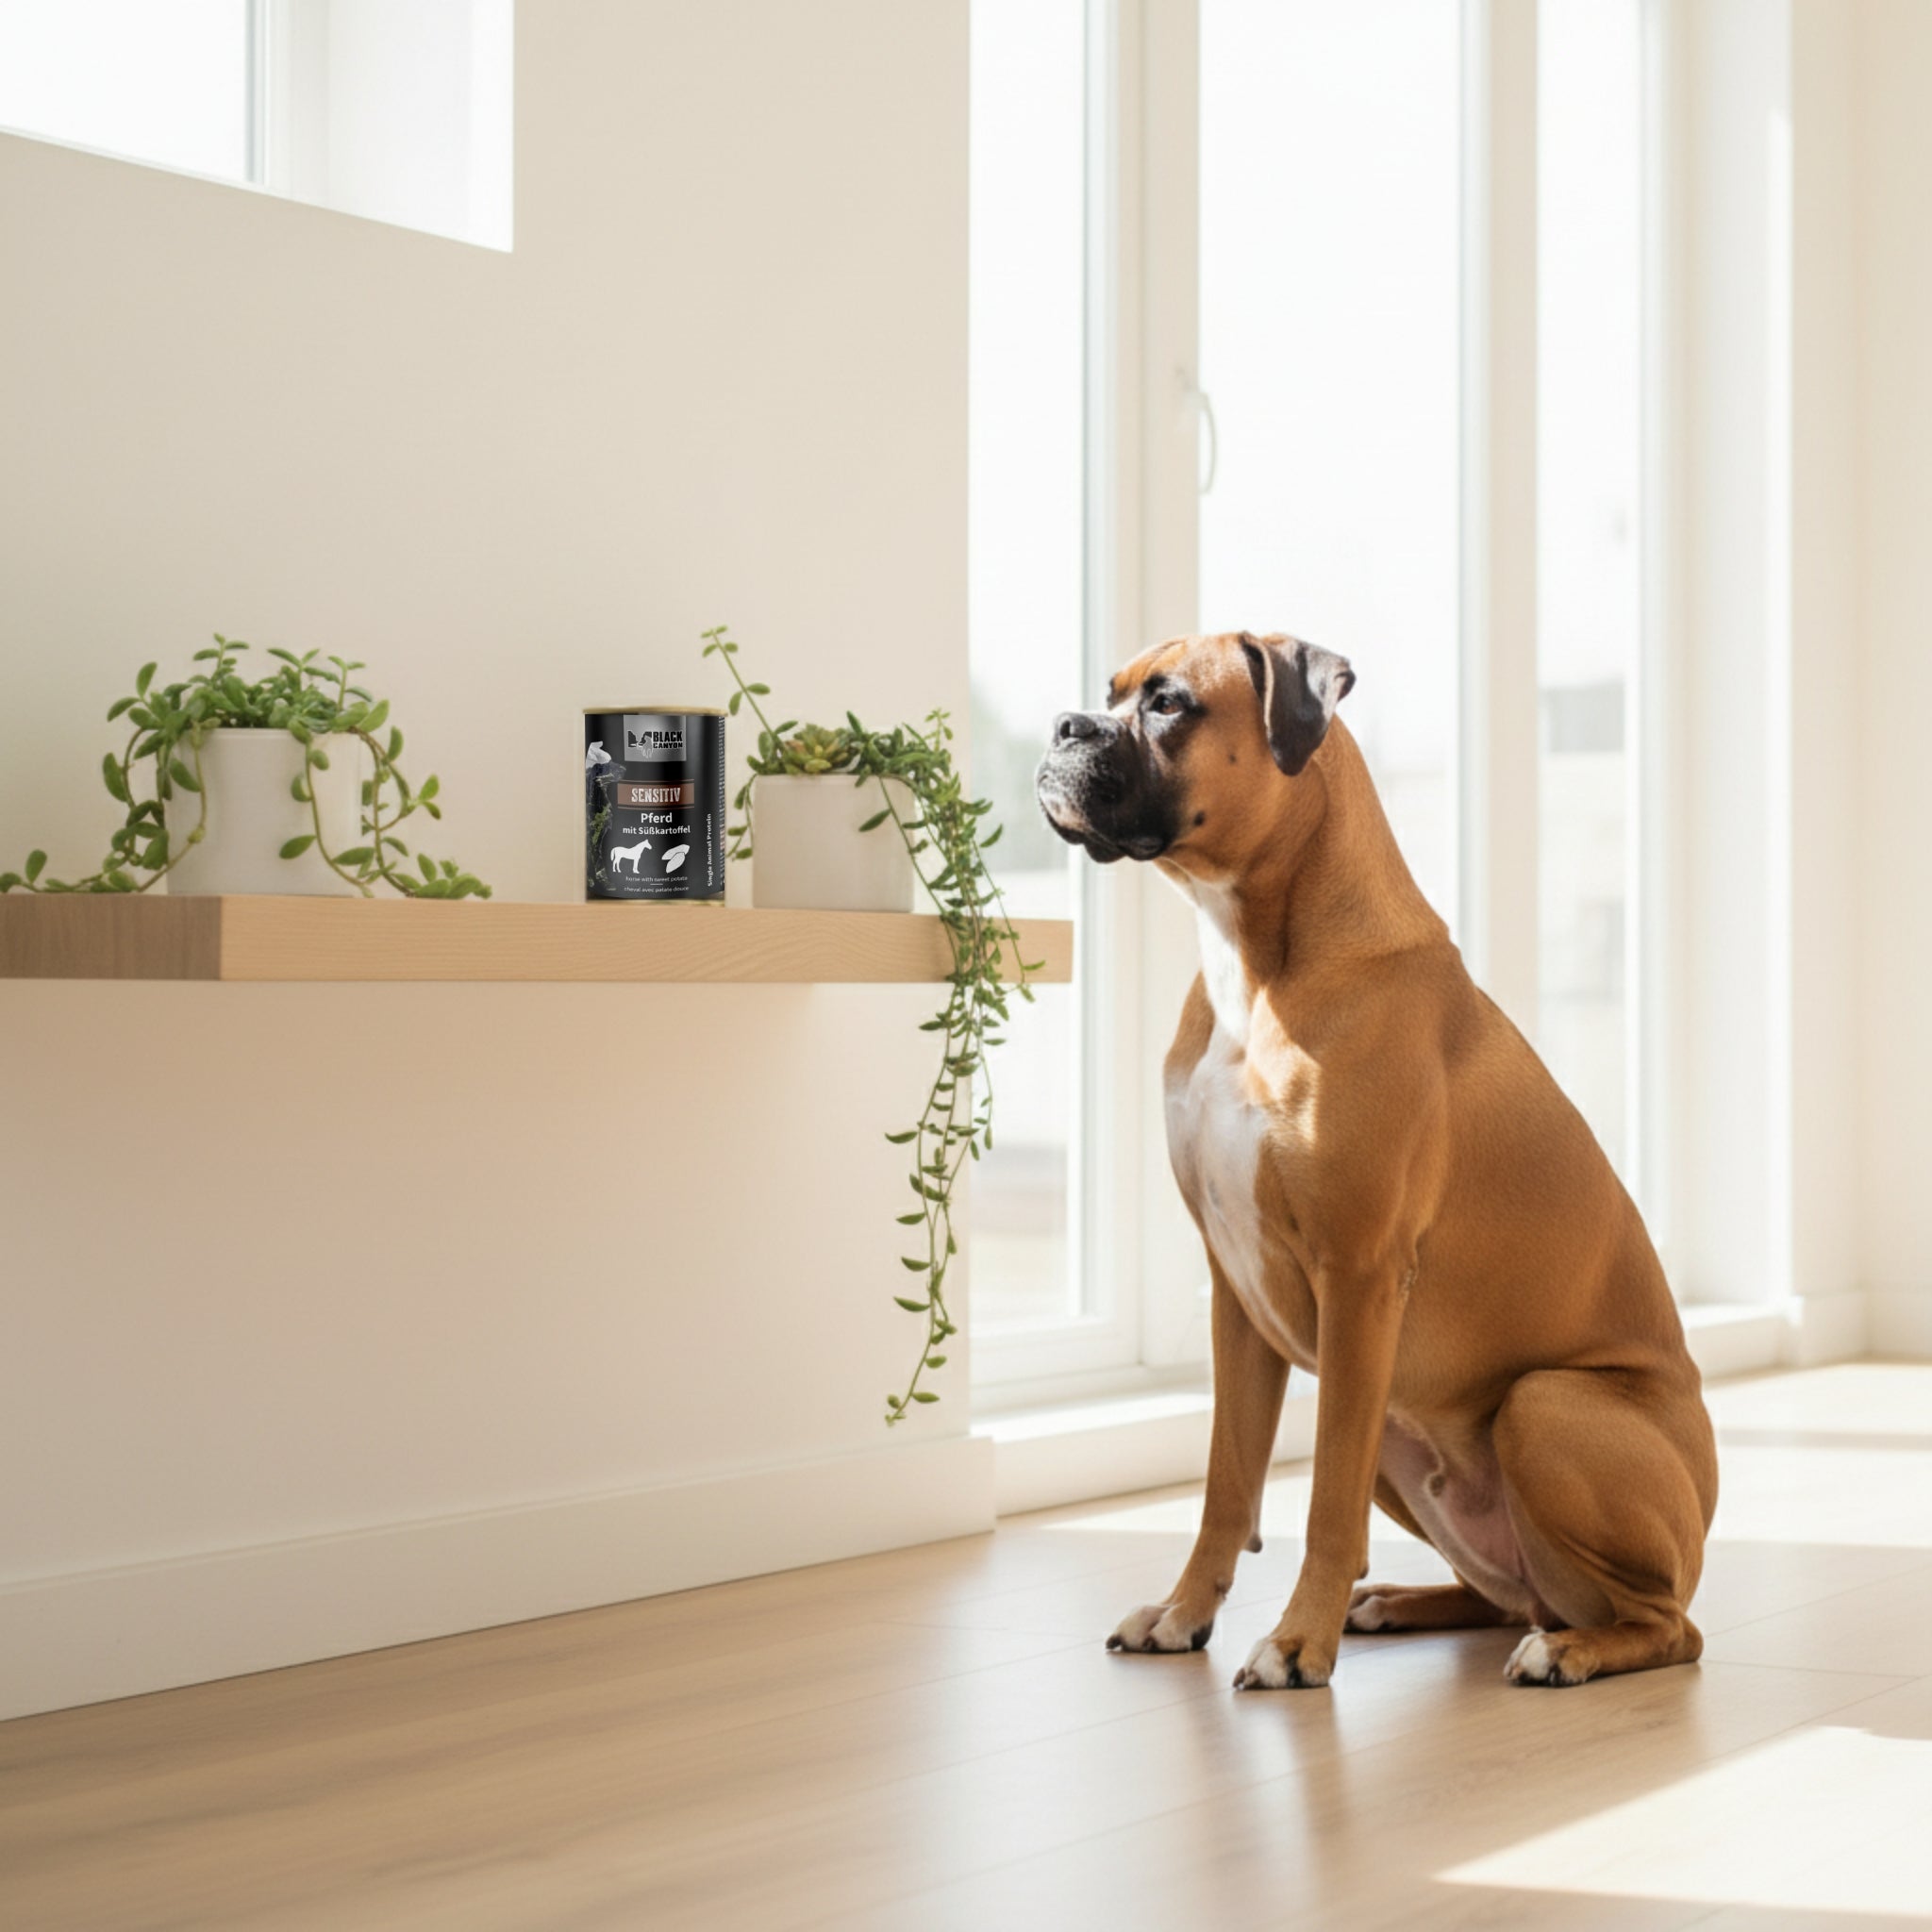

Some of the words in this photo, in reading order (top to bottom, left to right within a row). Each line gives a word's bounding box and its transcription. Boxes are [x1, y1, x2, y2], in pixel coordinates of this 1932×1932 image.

[653, 731, 683, 742] BLACK
[631, 787, 681, 803] SENSITIV
[641, 812, 673, 824] Pferd
[623, 825, 637, 835] mit
[638, 824, 691, 835] Süßkartoffel
